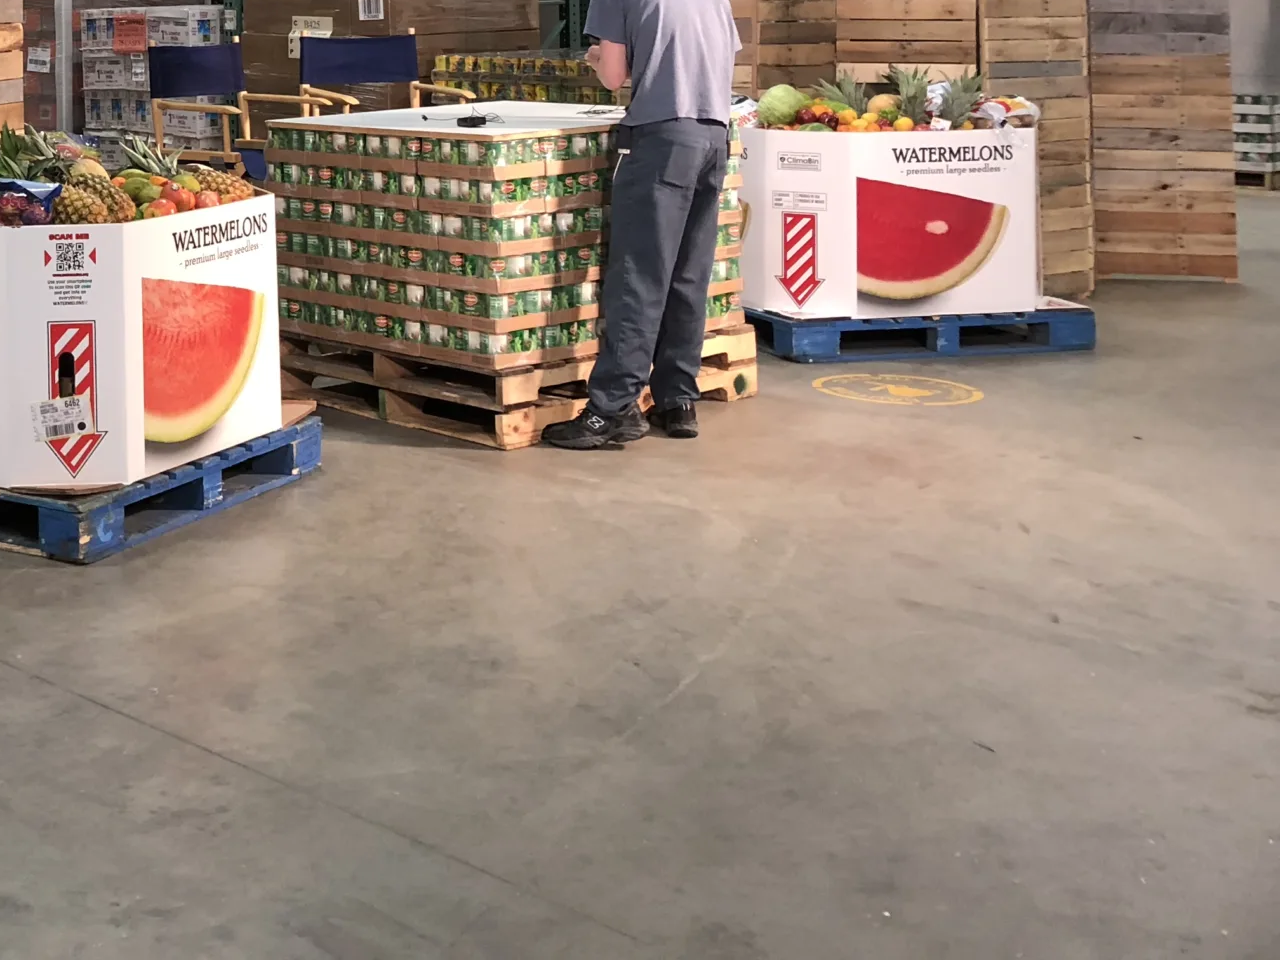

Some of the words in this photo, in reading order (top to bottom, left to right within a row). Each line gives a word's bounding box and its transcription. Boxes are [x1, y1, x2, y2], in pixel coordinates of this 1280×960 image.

[891, 145, 1014, 164] WATERMELONS
[906, 167, 945, 176] premium
[946, 165, 967, 175] large
[968, 163, 1001, 174] seedless
[172, 212, 268, 253] WATERMELONS
[184, 253, 216, 269] premium
[217, 246, 234, 261] large
[234, 240, 259, 256] seedless
[64, 398, 81, 408] 6462
